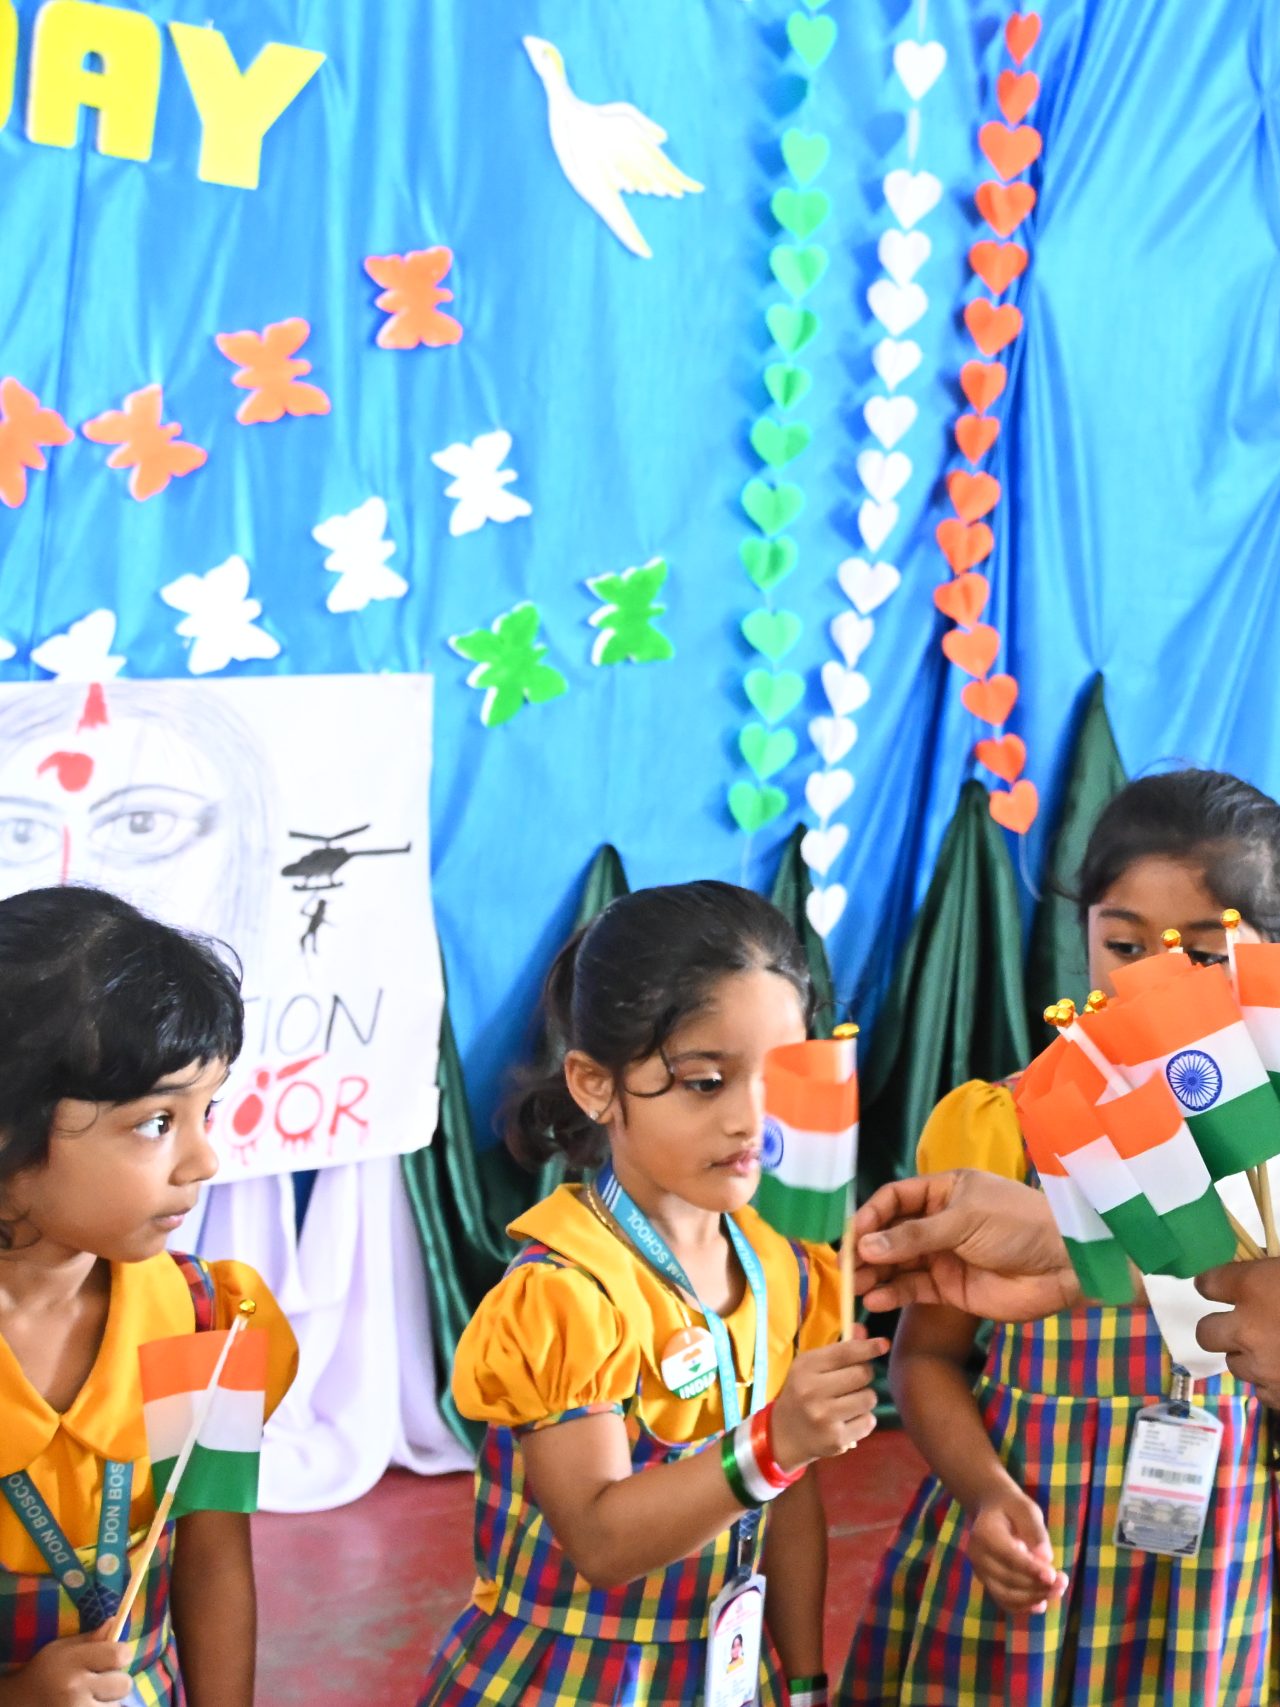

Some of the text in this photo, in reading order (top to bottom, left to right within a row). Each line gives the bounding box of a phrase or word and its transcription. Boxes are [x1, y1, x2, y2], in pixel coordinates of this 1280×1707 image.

[0, 0, 327, 190] AY
[242, 987, 384, 1056] ION
[626, 1208, 669, 1265] SCHOOL
[679, 1370, 717, 1400] INDIA
[7, 1474, 71, 1564] DON BOSCO
[103, 1462, 126, 1544] DON BOS
